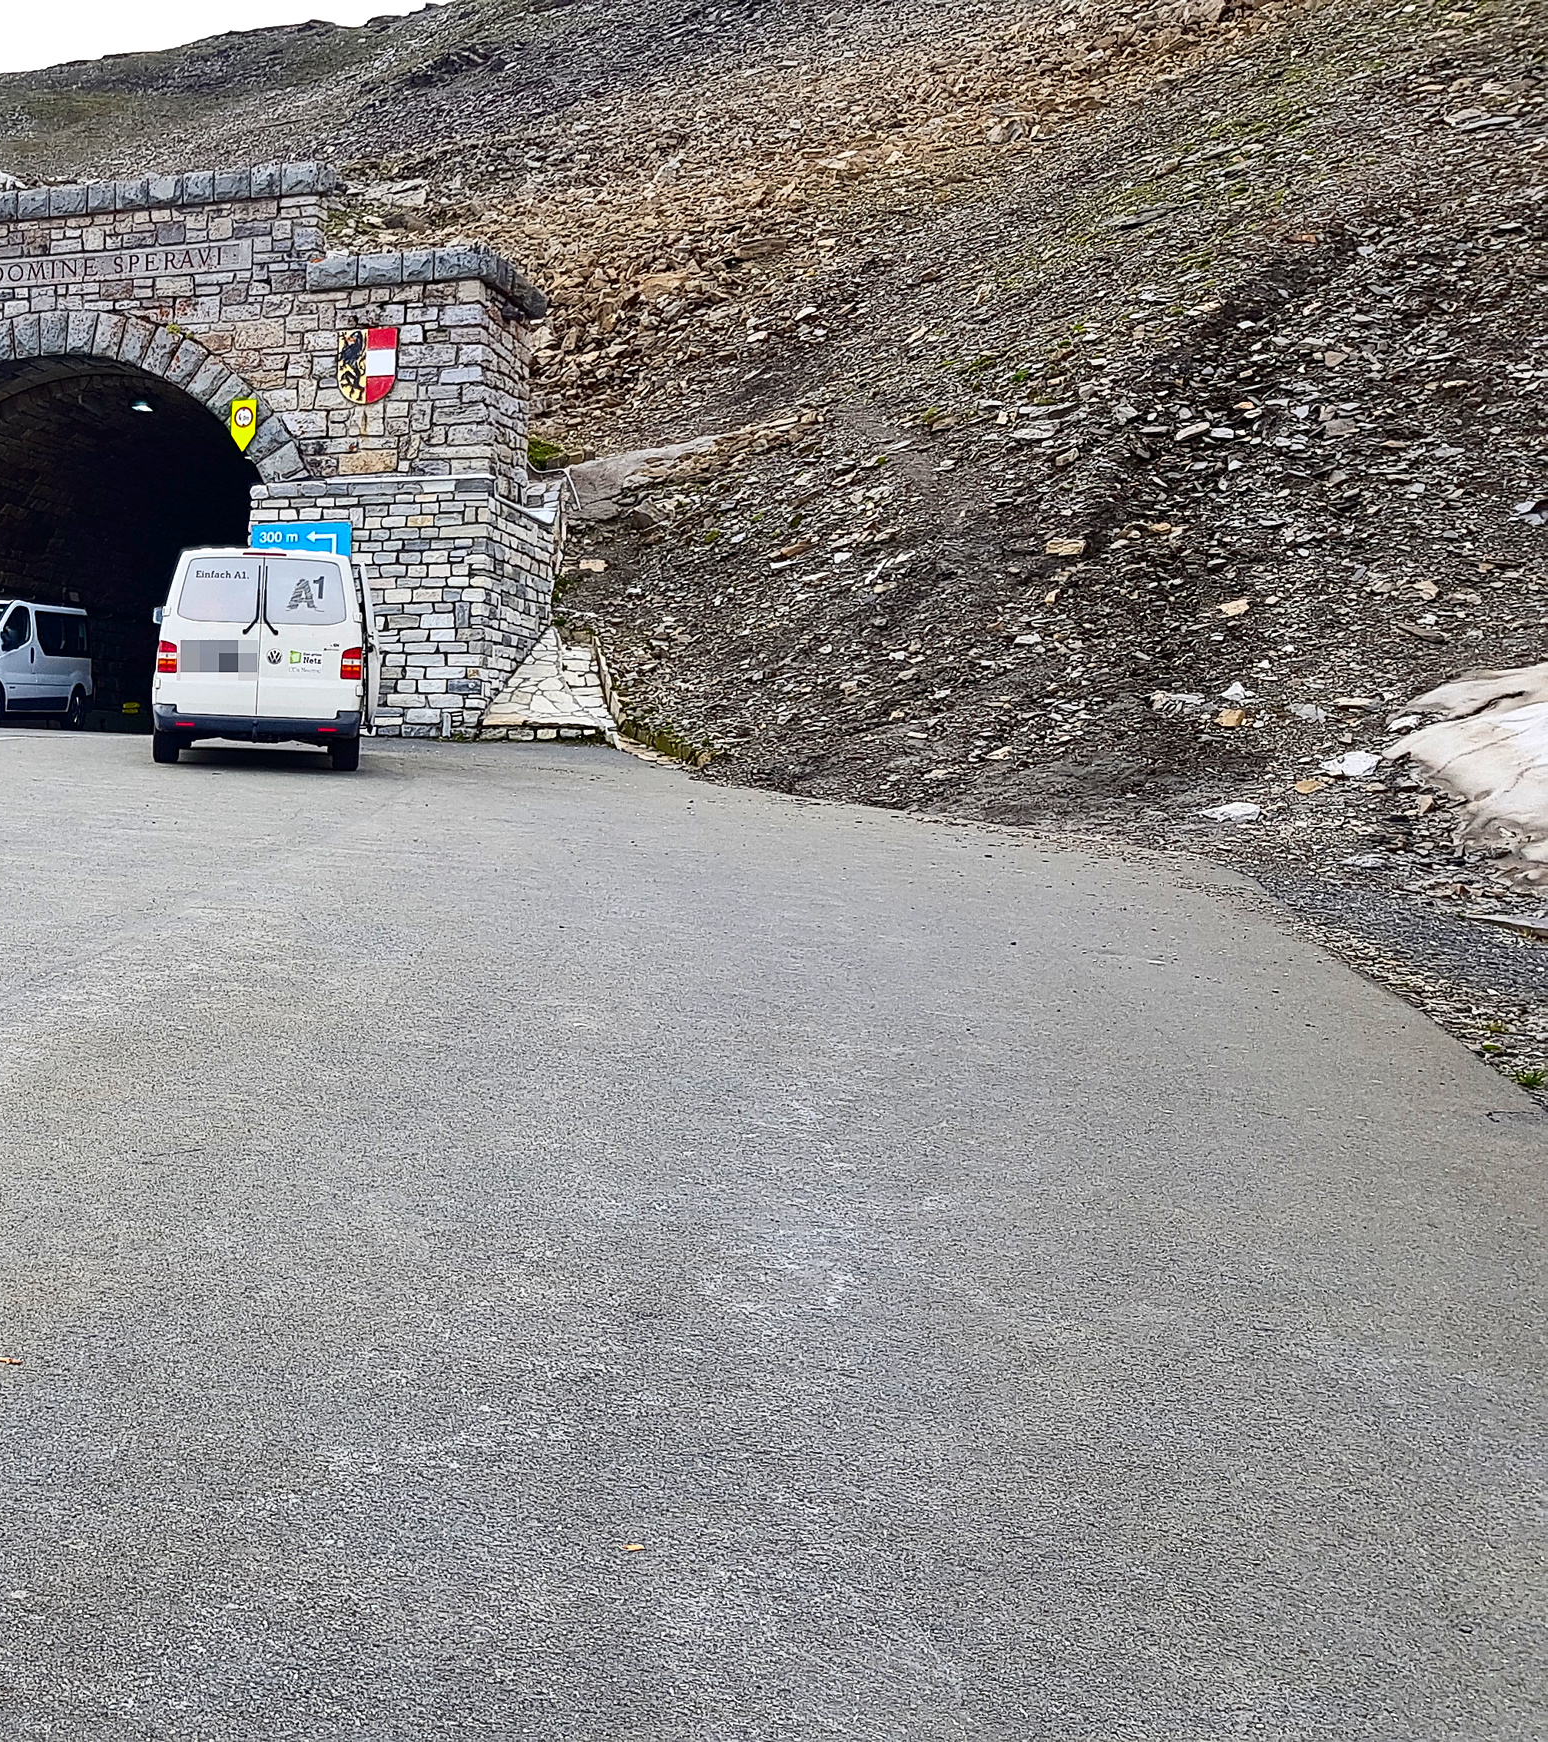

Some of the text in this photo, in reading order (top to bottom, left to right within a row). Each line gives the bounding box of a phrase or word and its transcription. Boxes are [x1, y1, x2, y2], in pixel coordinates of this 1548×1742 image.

[113, 247, 222, 274] SPERAVI
[259, 531, 298, 543] 300 m
[196, 570, 231, 579] Einfach
[286, 576, 325, 612] A1
